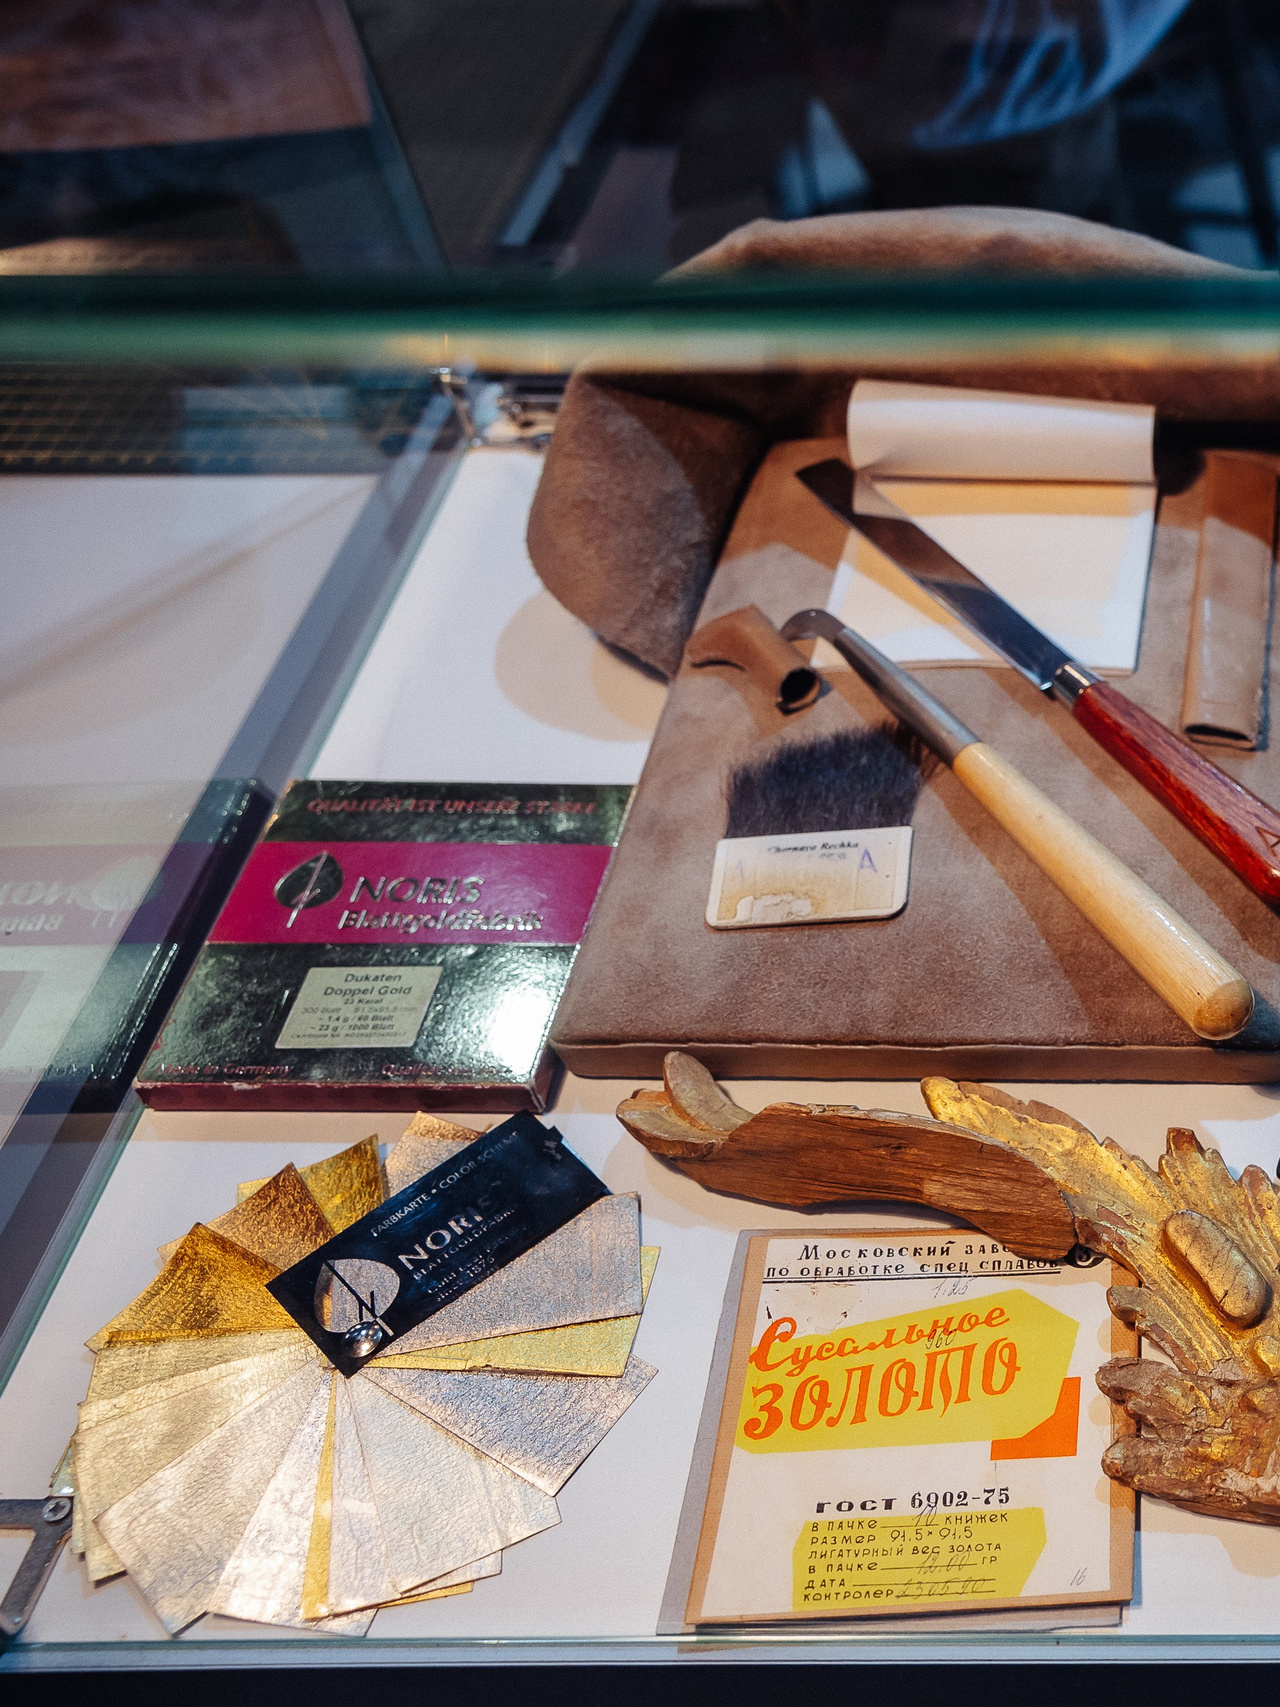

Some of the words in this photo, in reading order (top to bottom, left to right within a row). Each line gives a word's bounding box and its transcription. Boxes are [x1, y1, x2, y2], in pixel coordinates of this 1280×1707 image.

[350, 876, 486, 904] NORIS
[344, 973, 403, 983] Dukaten
[324, 986, 375, 998] Doppel
[378, 986, 413, 996] Gold
[203, 1063, 219, 1075] in
[223, 1063, 294, 1078] Germany
[439, 1161, 477, 1189] COLOR
[797, 1240, 957, 1262] Московский
[766, 1266, 790, 1278] ПО
[749, 1307, 1011, 1378] Сусальное
[744, 1337, 1022, 1440] ЗОЛОТО
[815, 1498, 898, 1514] ГОСТ
[910, 1487, 1011, 1510] 6902-75
[811, 1522, 820, 1532] В
[808, 1544, 905, 1560] ЛИГАТУРНЫЙ
[949, 1542, 1002, 1554] ЗОЛОТА
[809, 1565, 816, 1575] В
[805, 1579, 846, 1591] ДАТА
